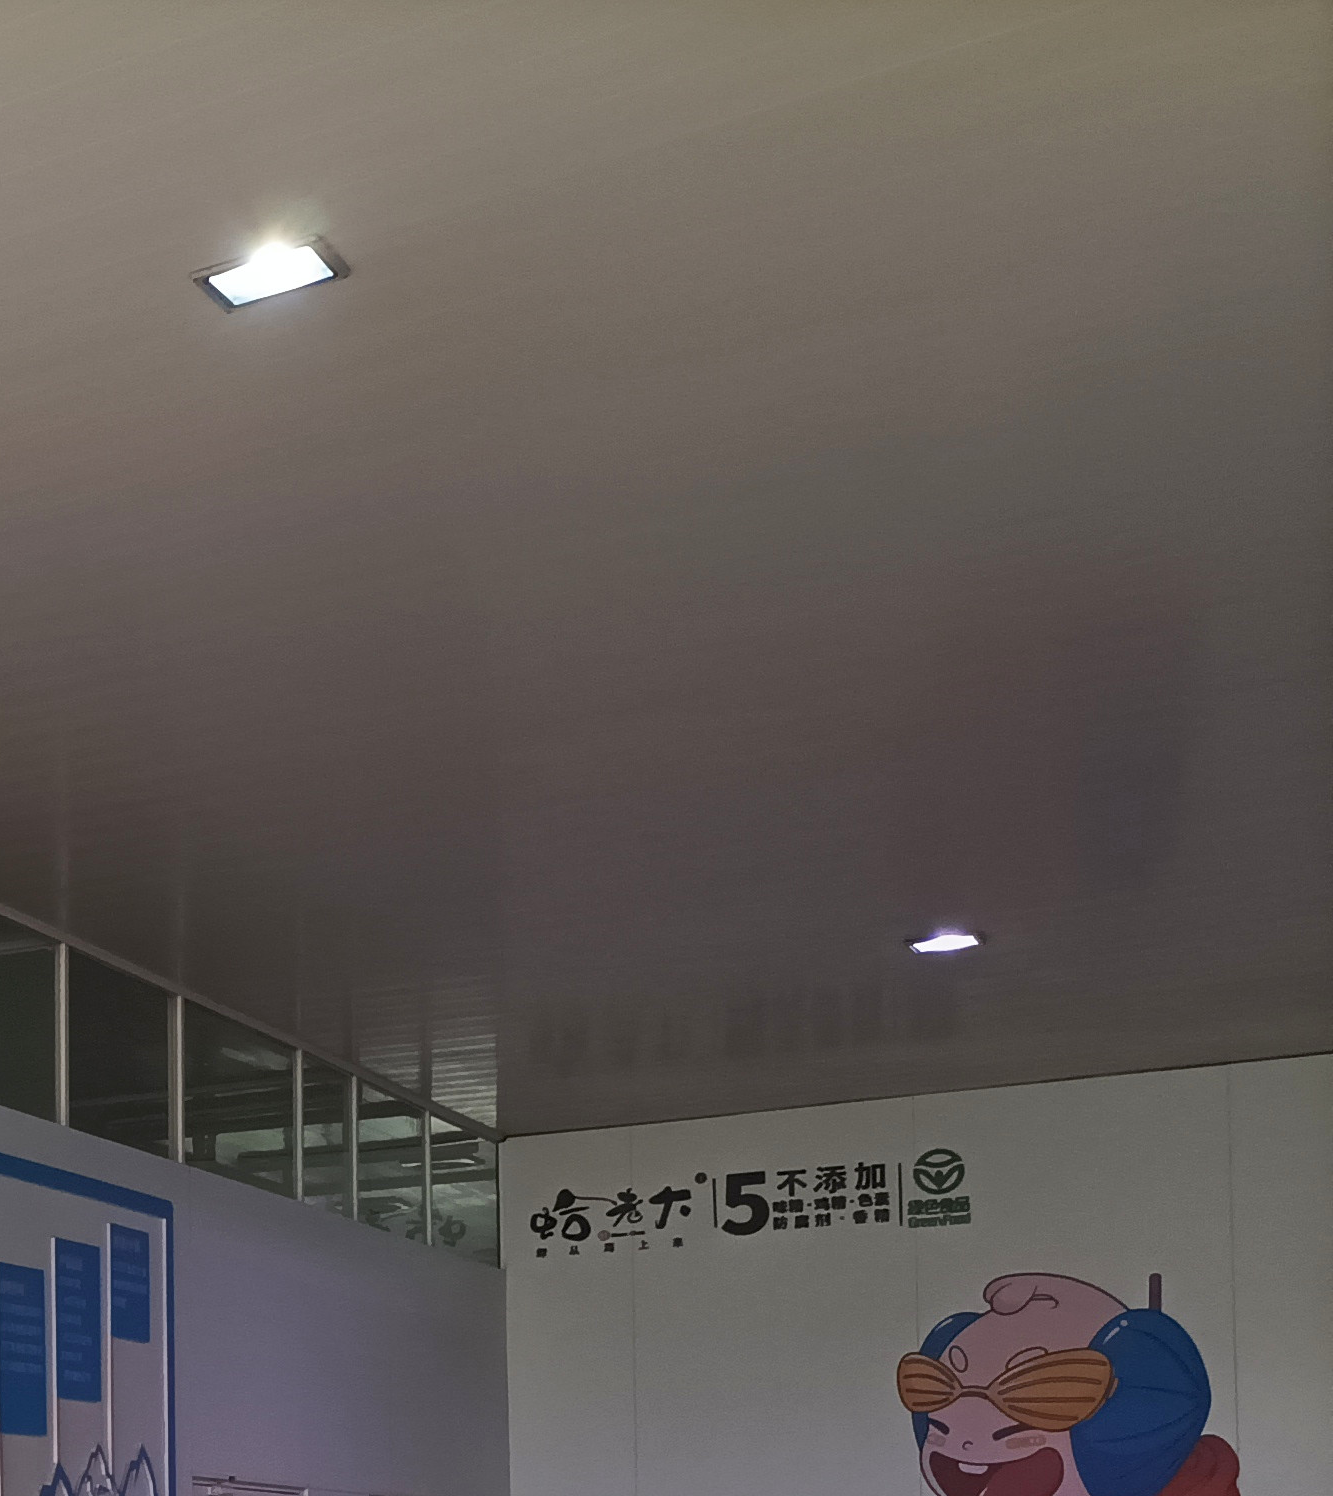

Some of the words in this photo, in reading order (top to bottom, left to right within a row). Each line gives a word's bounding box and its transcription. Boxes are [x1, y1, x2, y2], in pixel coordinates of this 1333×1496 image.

[721, 1170, 770, 1236] 5
[776, 1161, 887, 1197] 不添加
